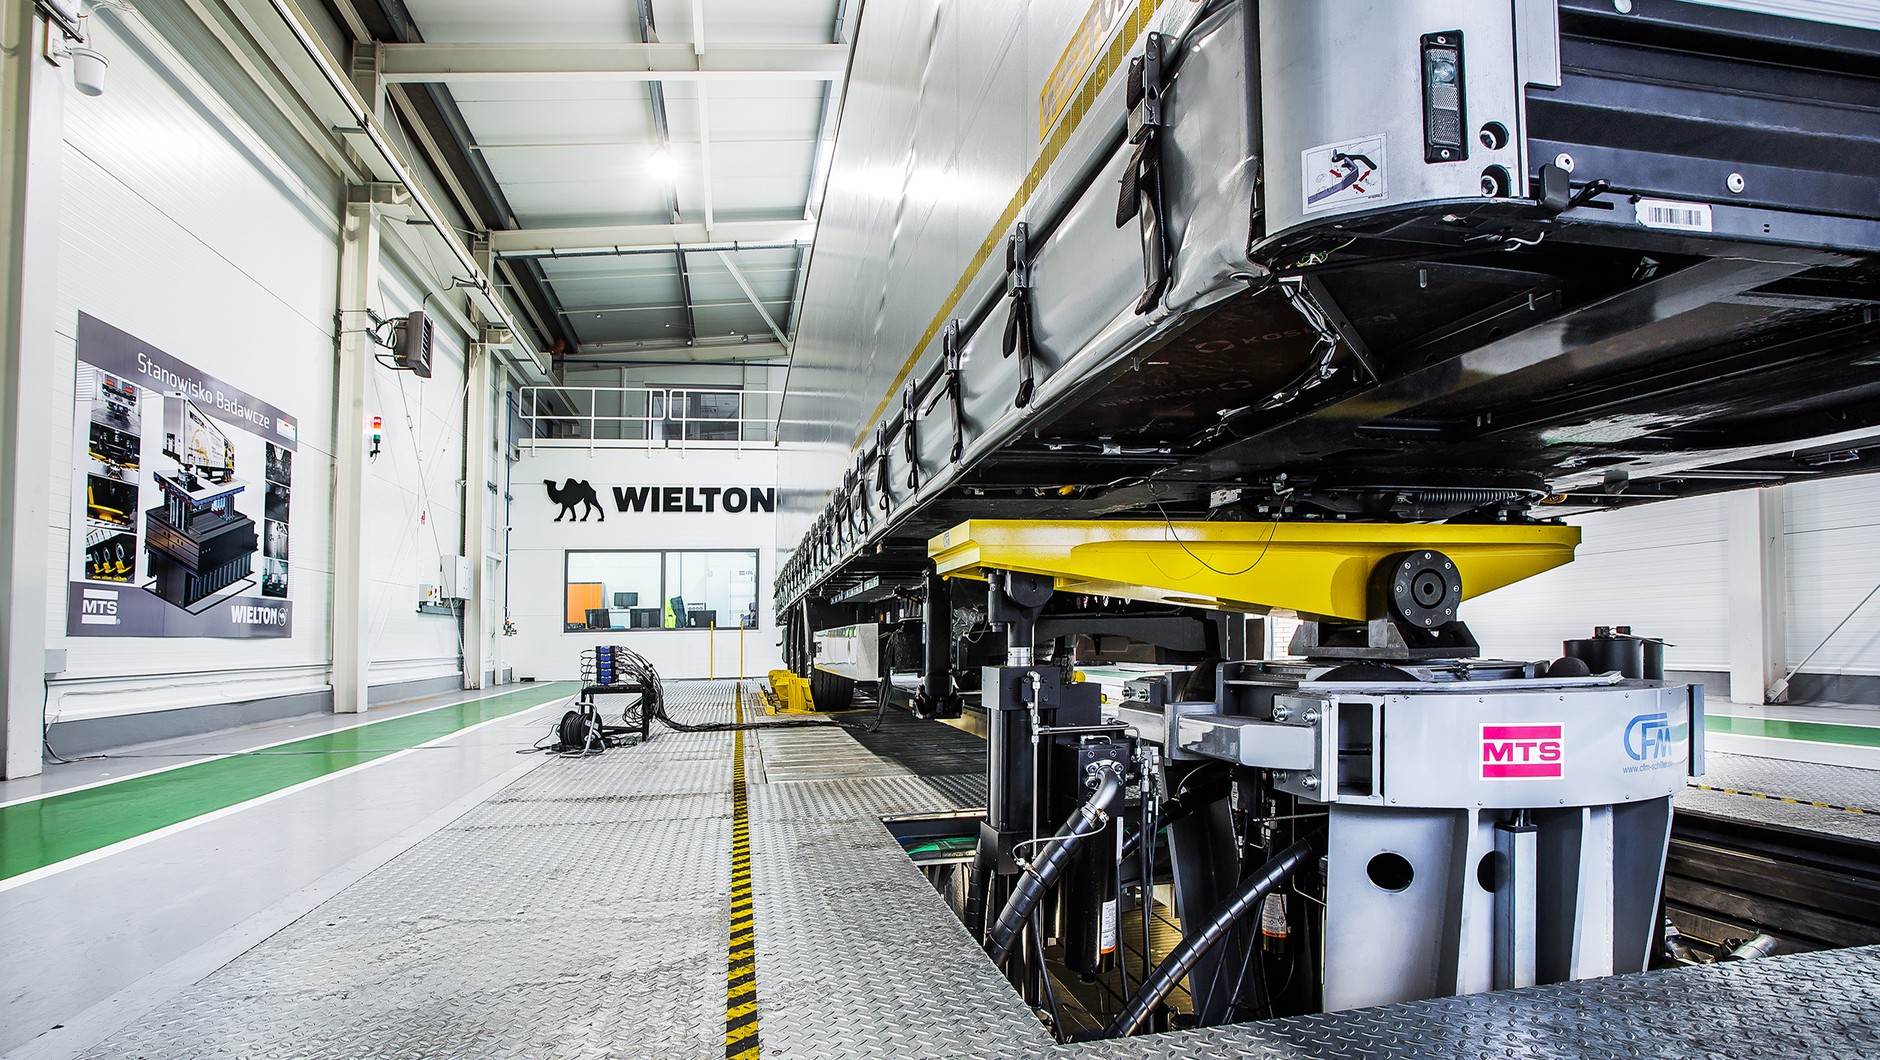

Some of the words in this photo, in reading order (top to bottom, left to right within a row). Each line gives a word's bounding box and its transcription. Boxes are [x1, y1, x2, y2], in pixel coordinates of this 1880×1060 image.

[138, 352, 213, 404] Stanowisko
[216, 390, 270, 429] Badawcze
[612, 486, 775, 513] WIELTON
[82, 600, 118, 614] MTS
[231, 605, 278, 624] WIELTON
[1623, 711, 1673, 761] CFM
[1483, 741, 1562, 762] MTS
